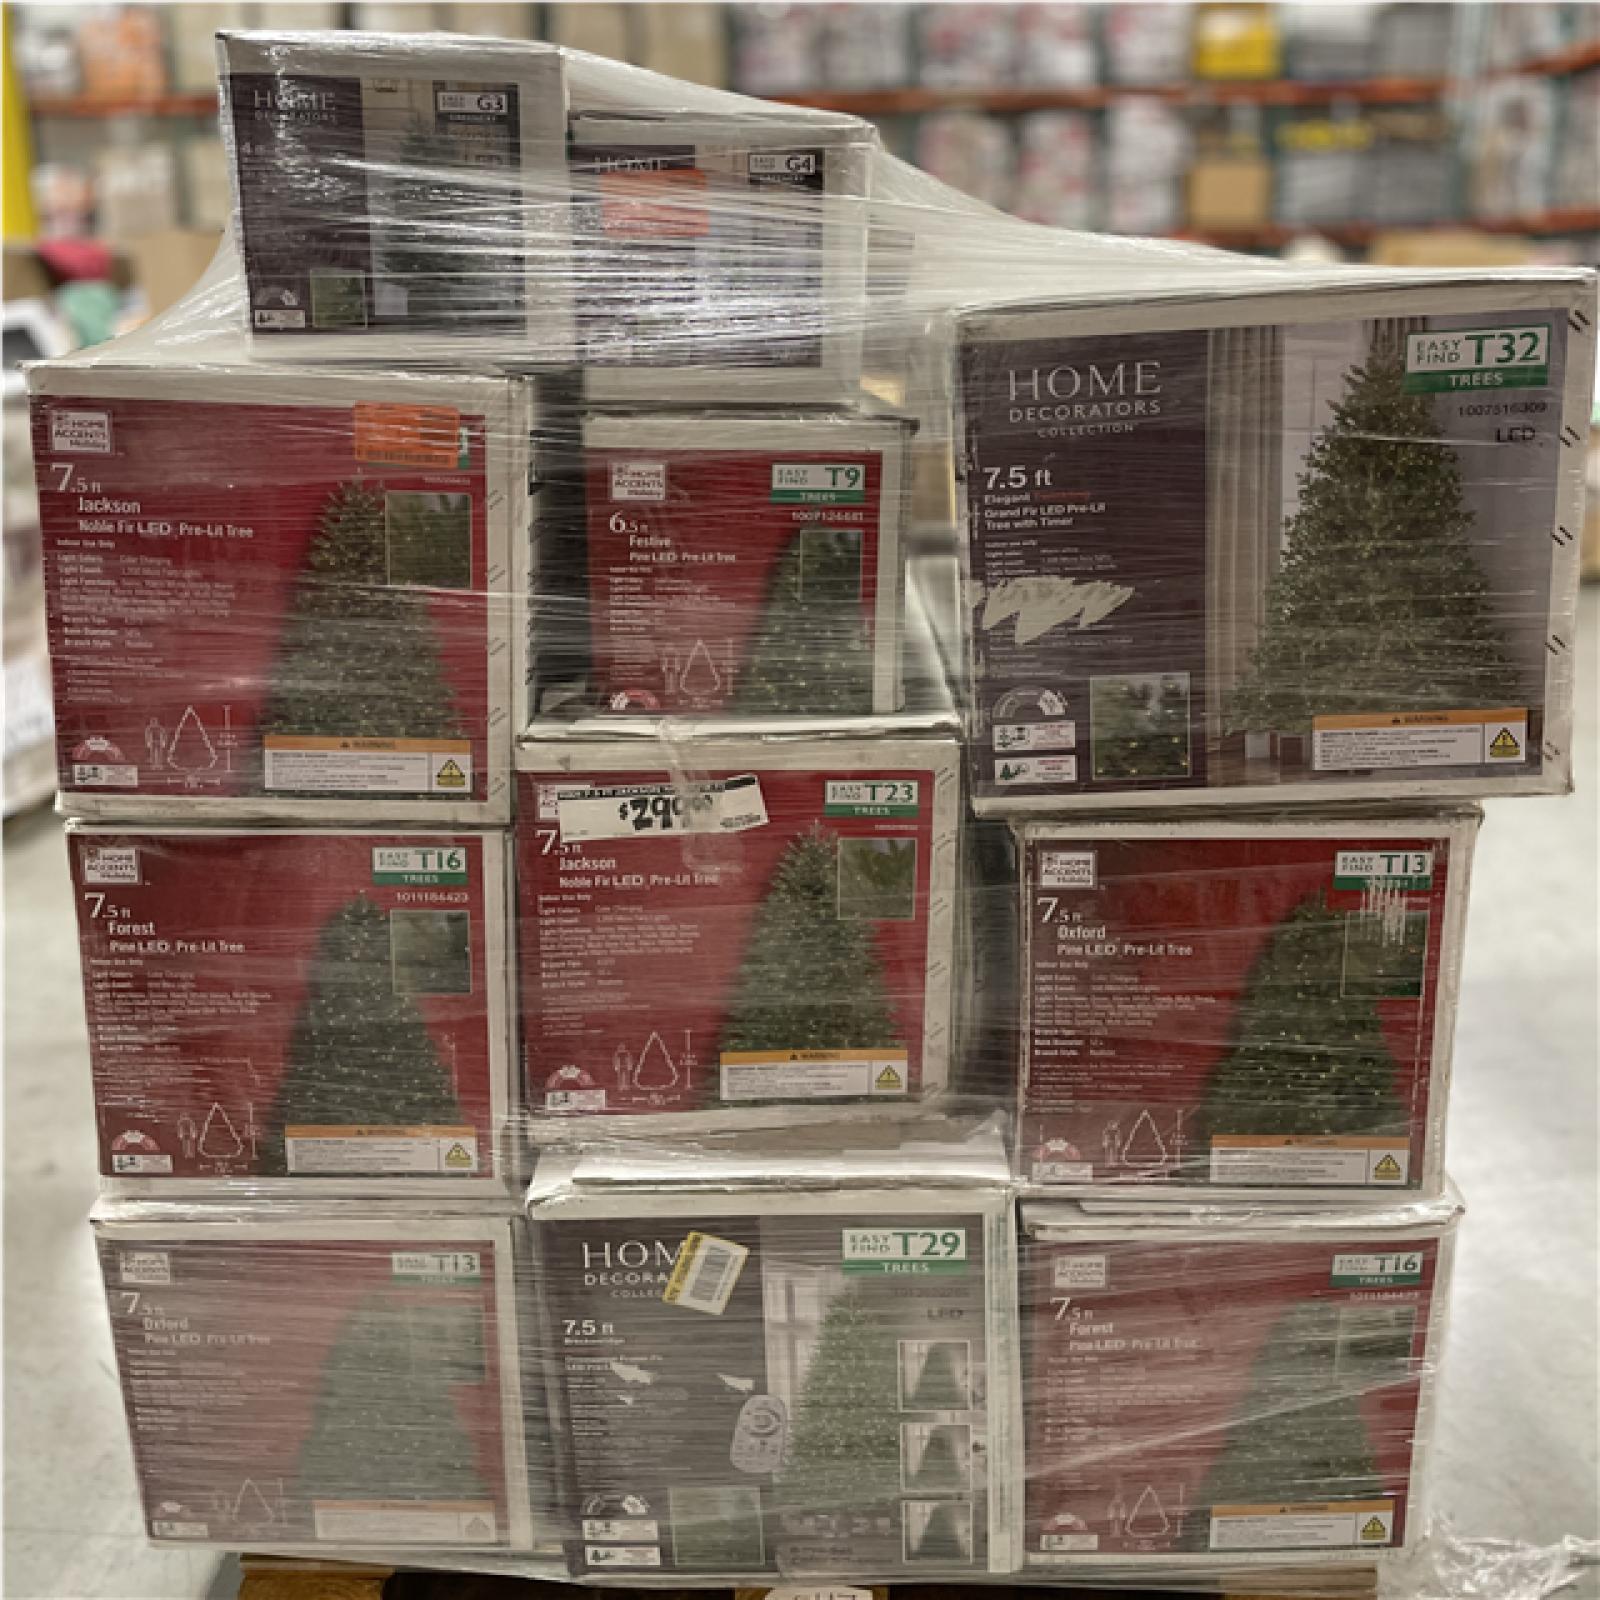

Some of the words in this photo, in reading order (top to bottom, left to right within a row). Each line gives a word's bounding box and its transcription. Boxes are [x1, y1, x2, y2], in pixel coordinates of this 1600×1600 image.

[477, 94, 504, 111] G3
[785, 156, 811, 172] G4
[1417, 340, 1460, 352] EASY
[1465, 332, 1541, 366] T32
[1417, 352, 1461, 364] FIND
[1009, 361, 1161, 400] HOME
[1449, 373, 1504, 387] TREES
[1009, 400, 1161, 423] DECORATORS
[72, 420, 104, 428] HOME
[1037, 423, 1133, 438] COLLECTION
[54, 430, 106, 439] ACCENTS
[1496, 427, 1536, 443] LED
[614, 480, 664, 489] ACCENTS
[825, 467, 861, 488] T9
[983, 465, 1027, 489] 7.5
[1034, 469, 1052, 486] ft
[78, 497, 141, 514] Jackson
[1040, 504, 1065, 516] LED
[1067, 502, 1106, 514] Pre-Lit
[79, 519, 115, 533] Noble
[117, 520, 134, 534] Fir
[137, 521, 171, 536] LED
[179, 523, 224, 537] Pre-Lit
[226, 524, 254, 538] Tree
[652, 552, 678, 563] LED
[864, 782, 914, 803] T23
[414, 848, 462, 871] T16
[560, 857, 615, 871] Jackson
[1380, 854, 1425, 874] T13
[560, 877, 592, 888] Noble
[614, 874, 645, 887] LED
[109, 921, 156, 936] Forest
[1057, 925, 1106, 940] Oxford
[110, 940, 136, 953] Pine
[138, 940, 170, 954] LED
[175, 940, 216, 954] Pre-Lit
[219, 939, 246, 953] Tree
[1057, 944, 1083, 956] Pine
[1085, 944, 1117, 956] LED
[1124, 944, 1165, 956] Pre-Lit
[1167, 943, 1193, 956] Tree
[891, 1231, 961, 1257] T29
[583, 1239, 689, 1269] HOM
[431, 1253, 477, 1274] T13
[881, 1262, 931, 1274] TREES
[1374, 1252, 1418, 1273] T16
[584, 1271, 669, 1287] DECORA
[561, 1319, 596, 1336] 7.5
